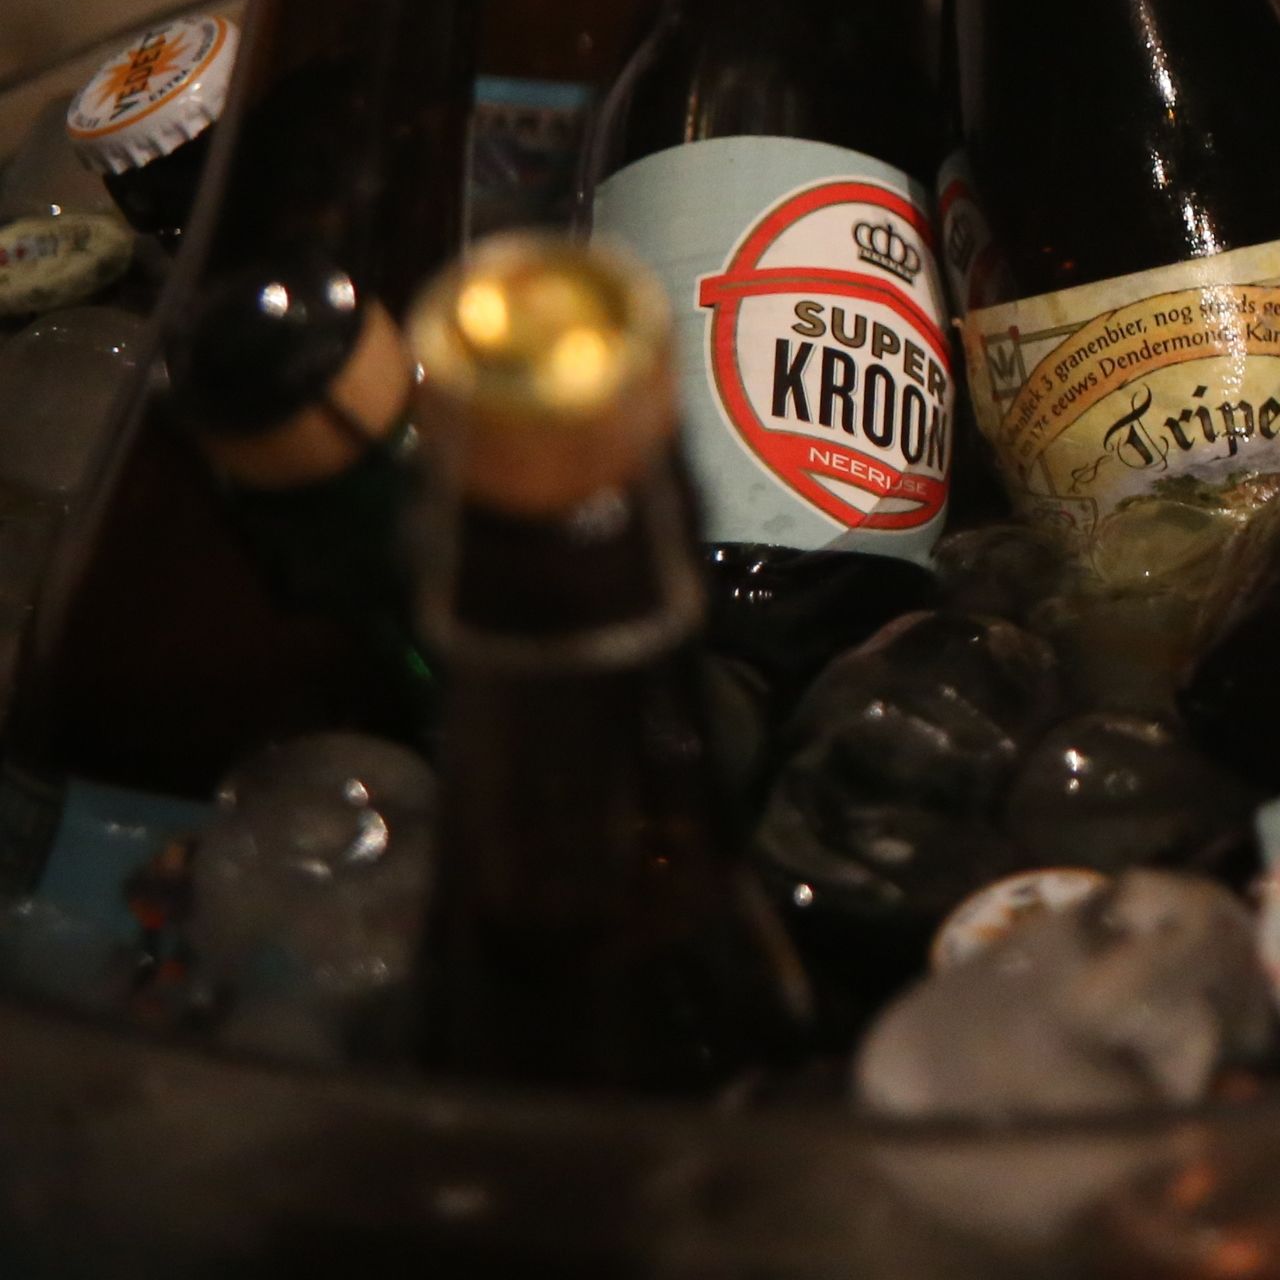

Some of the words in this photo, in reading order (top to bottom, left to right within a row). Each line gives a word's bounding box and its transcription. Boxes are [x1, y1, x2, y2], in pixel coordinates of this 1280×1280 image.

[791, 300, 947, 406] SUPER
[1040, 375, 1054, 392] 3
[1054, 317, 1149, 383] granenbier,
[1153, 304, 1193, 327] nog
[1051, 370, 1099, 418] eeuws
[771, 337, 947, 473] KROON
